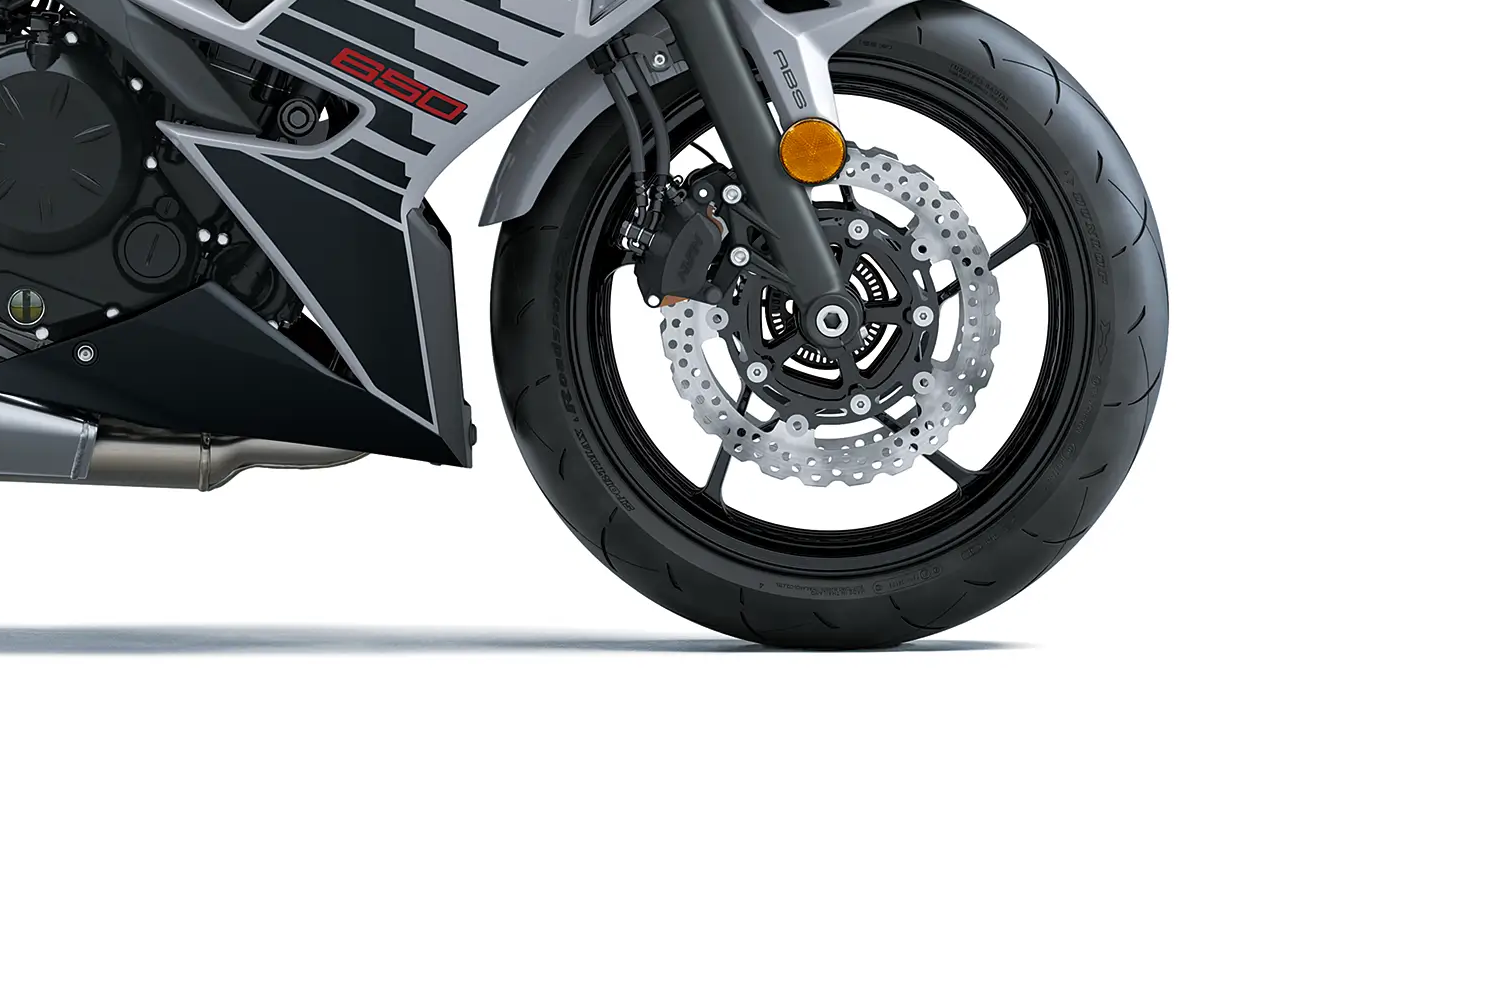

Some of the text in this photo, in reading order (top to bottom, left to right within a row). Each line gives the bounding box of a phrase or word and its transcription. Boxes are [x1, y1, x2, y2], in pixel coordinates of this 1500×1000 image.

[331, 47, 468, 121] 650
[773, 49, 807, 109] ABS
[1069, 187, 1109, 284] DUNLOP
